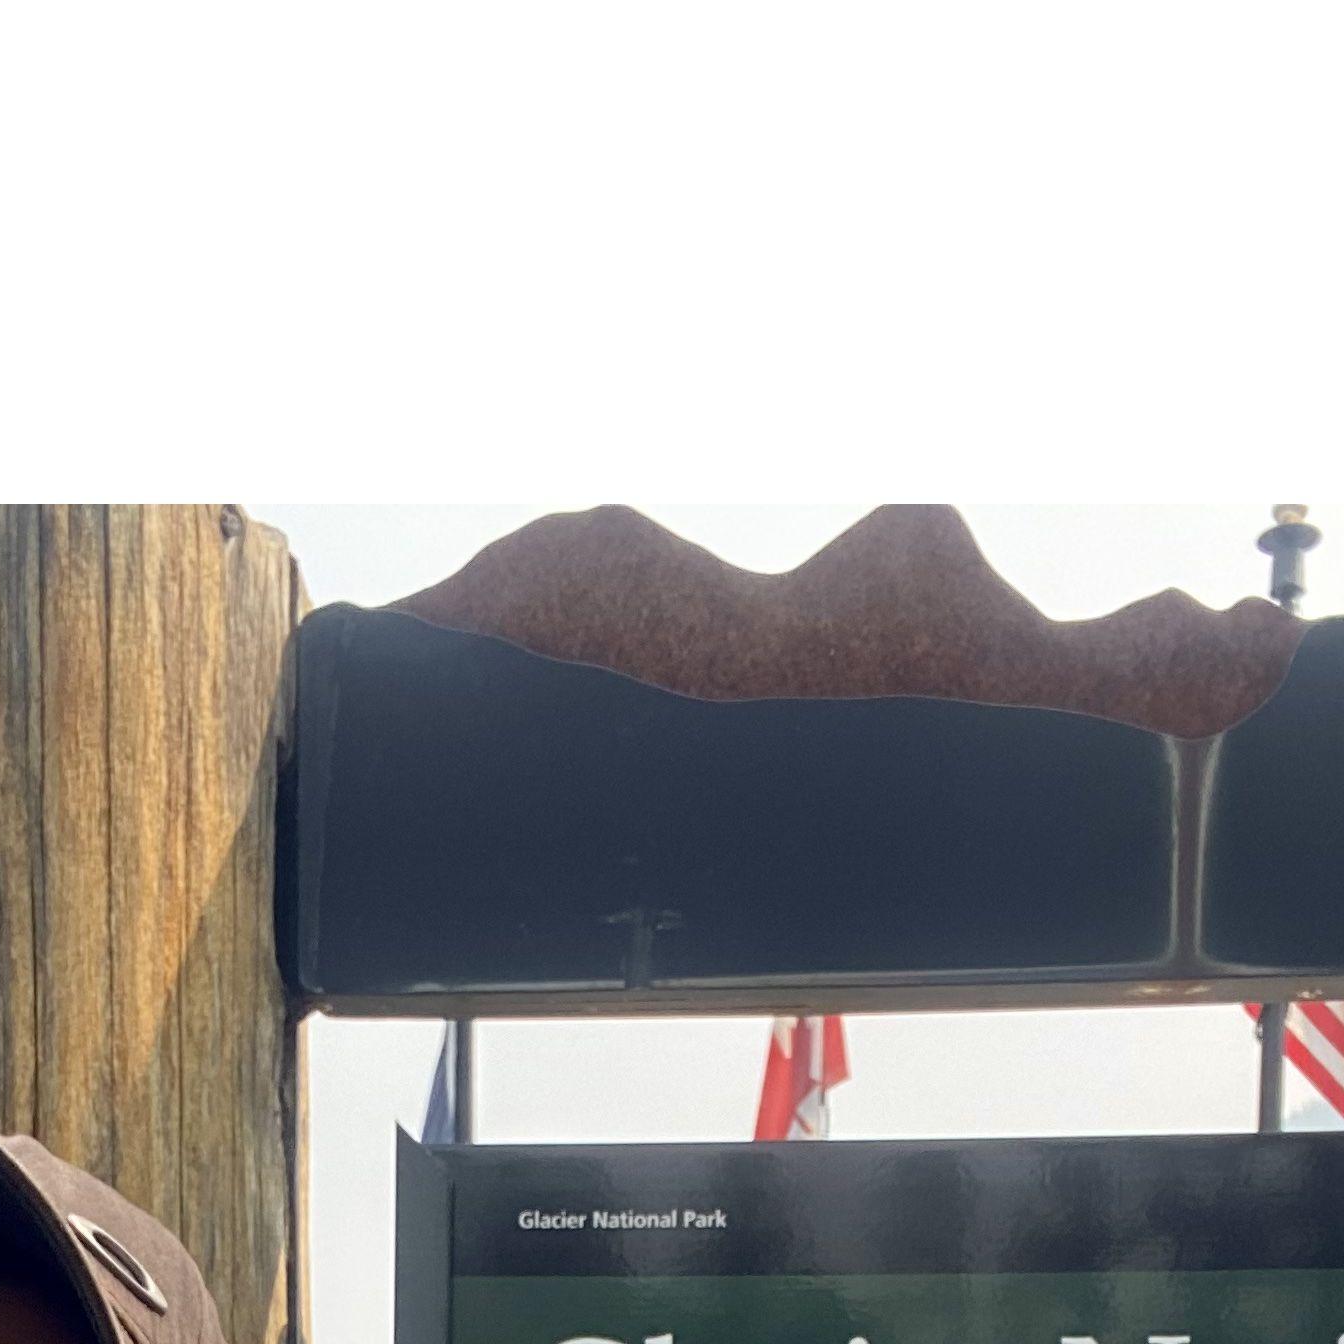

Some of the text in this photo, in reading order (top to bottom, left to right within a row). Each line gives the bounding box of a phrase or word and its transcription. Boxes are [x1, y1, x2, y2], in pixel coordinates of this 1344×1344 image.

[517, 1208, 728, 1230] Glacier National Park
